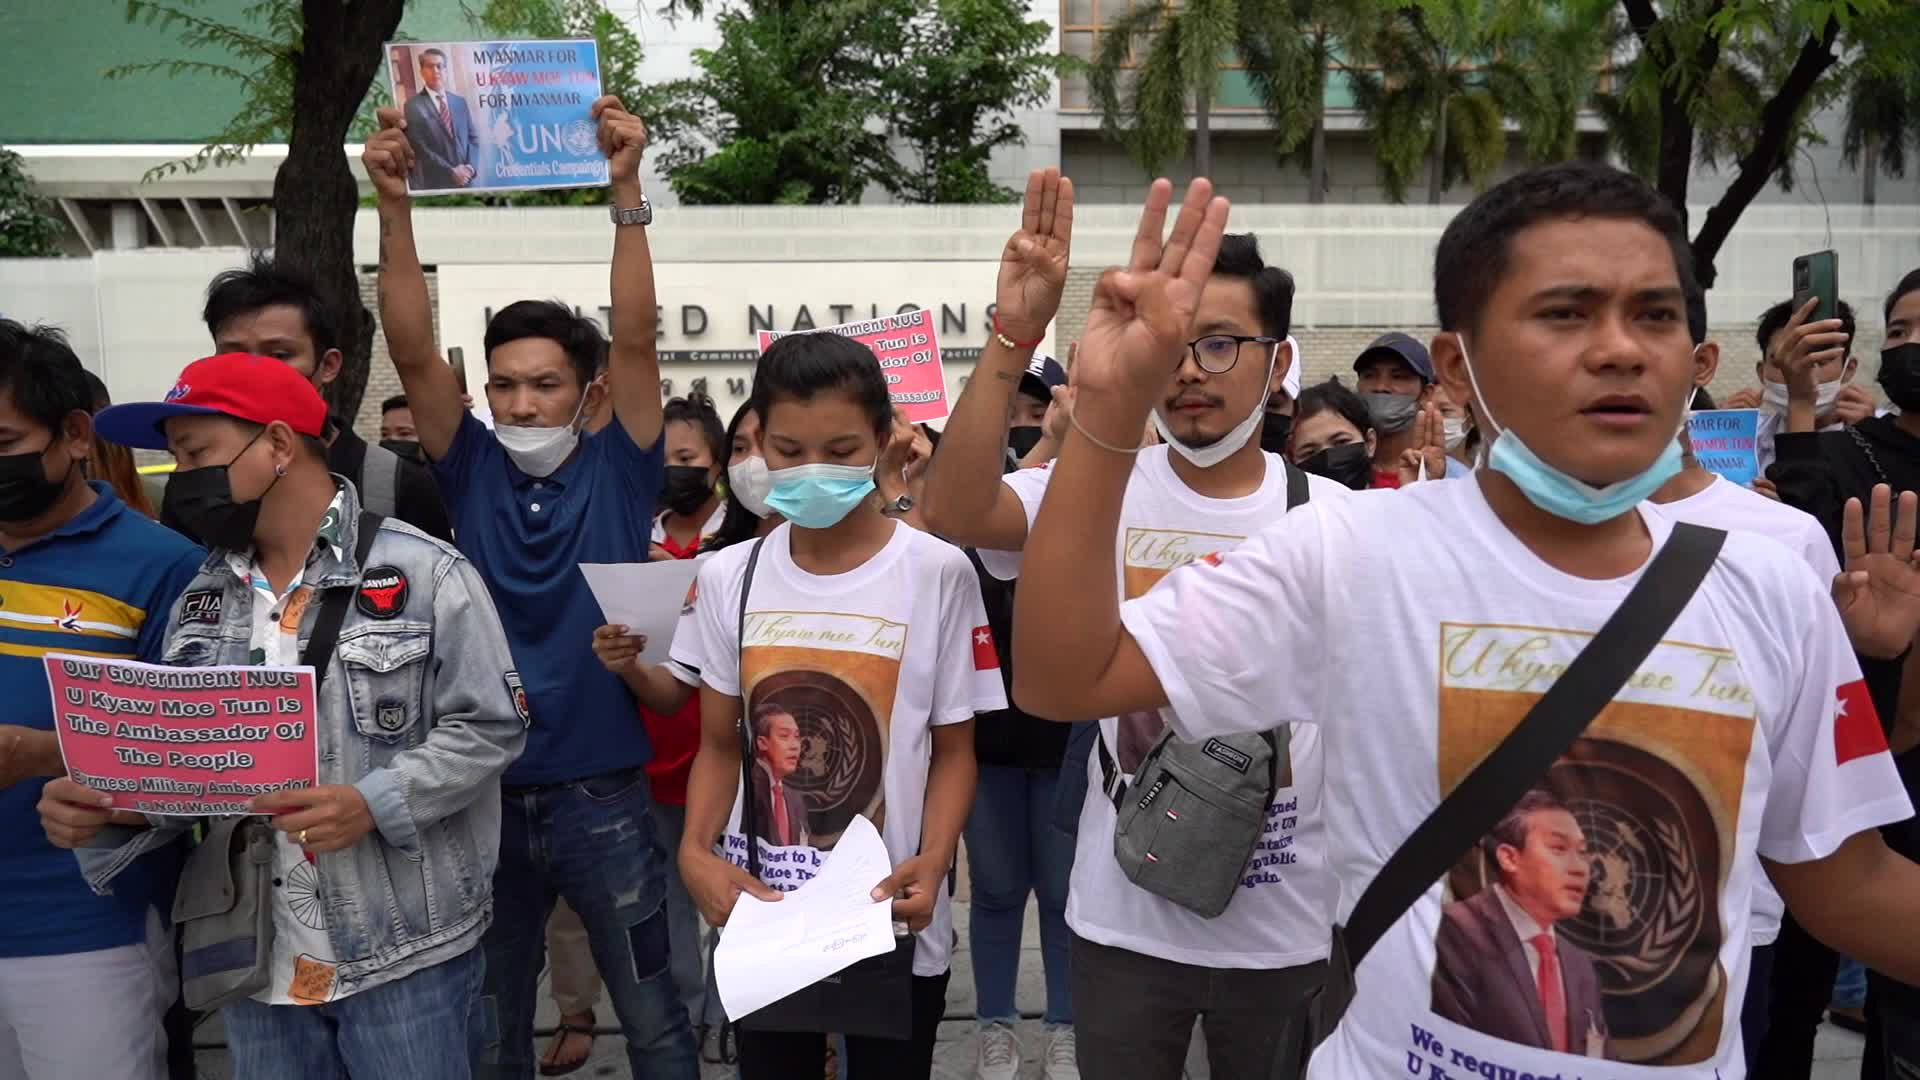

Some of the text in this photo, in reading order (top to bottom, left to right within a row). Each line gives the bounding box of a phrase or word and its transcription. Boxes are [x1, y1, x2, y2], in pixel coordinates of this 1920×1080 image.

[473, 49, 577, 65] MYANMAR FOR
[476, 72, 486, 87] U
[479, 91, 581, 109] FOR MYANMAR
[516, 121, 563, 155] UN
[889, 311, 924, 329] NUG
[876, 337, 908, 351] Tun
[911, 333, 928, 345] Is
[912, 349, 934, 364] Of
[888, 390, 944, 404] bassador
[63, 659, 298, 688] Our Government NUG
[65, 687, 301, 717] U Kyaw Moe Tun Is
[65, 713, 304, 743] The Ambassador Of
[114, 747, 253, 771] The People
[141, 777, 205, 796] Military
[207, 778, 312, 794] Ambassador
[153, 801, 183, 813] Not
[728, 834, 746, 850] We
[792, 850, 807, 864] to
[1241, 871, 1281, 888] gain
[1410, 1023, 1444, 1058] We
[1407, 1050, 1423, 1075] U
